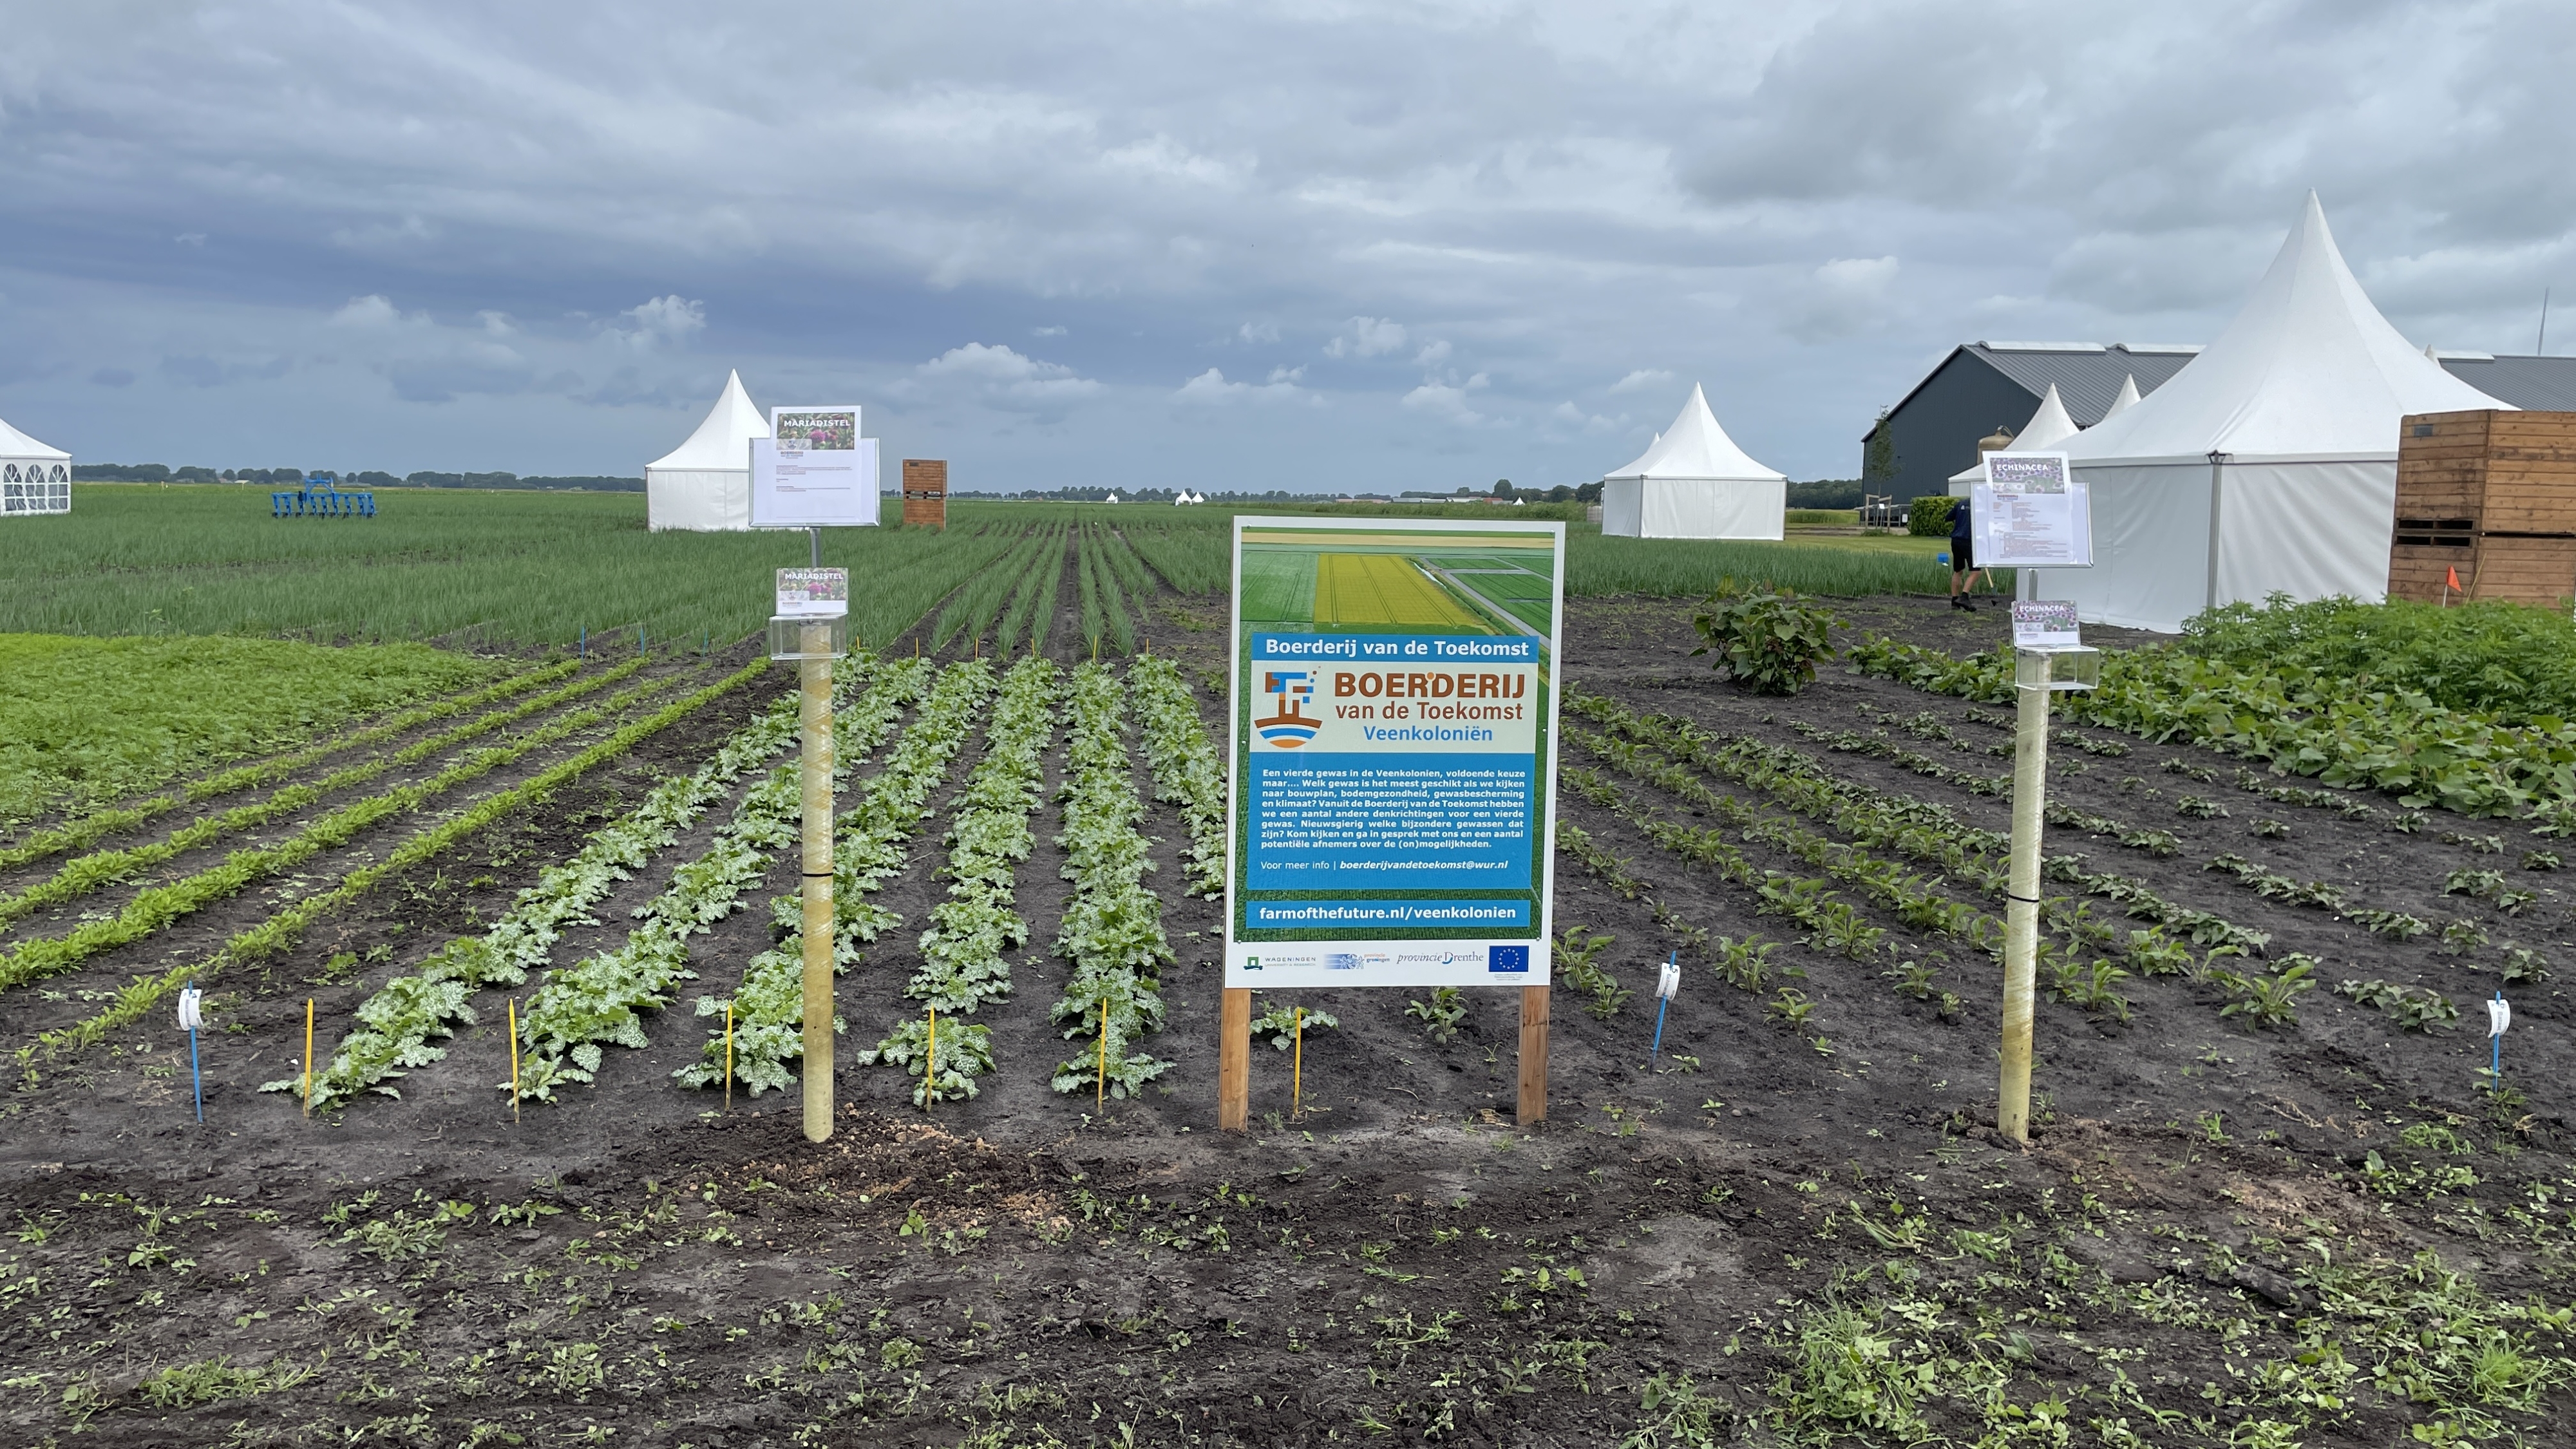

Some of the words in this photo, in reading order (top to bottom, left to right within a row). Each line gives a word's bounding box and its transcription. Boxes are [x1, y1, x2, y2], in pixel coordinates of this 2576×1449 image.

[1267, 639, 1356, 657] Boerderij
[1363, 643, 1397, 654] van
[1405, 641, 1427, 654] de
[1434, 641, 1528, 656] Toekomst
[1335, 672, 1524, 698] BOERDERIJ
[1336, 706, 1373, 719] van
[1383, 701, 1408, 719] de
[1417, 701, 1522, 719] Toekomst
[1364, 726, 1492, 741] Veenkoloniën
[1376, 770, 1443, 778] Veenkolonien,
[1421, 780, 1461, 788] geschikt
[1497, 780, 1524, 788] kijken
[1288, 790, 1336, 798] bouwplan,
[1341, 790, 1430, 798] bodemgezondheid,
[1434, 790, 1524, 799] gewasbescherming
[1365, 800, 1408, 808] Boerderij
[1373, 810, 1443, 819] denkrichtingen
[1302, 820, 1363, 829] Nieuwsgierig
[1402, 820, 1451, 829] bijzondere
[1262, 830, 1284, 839] zijn?
[1311, 830, 1339, 838] kijken
[1381, 830, 1419, 838] gesprek
[1262, 840, 1309, 849] potentiële
[1399, 840, 1491, 849] (on)mogelijkheden.
[1340, 861, 1508, 870] boerderijvandetoekomst@wur.nl
[1260, 907, 1515, 920] farmofthefuture.nl/veenkolonien
[1397, 952, 1442, 964] provincie
[1442, 952, 1484, 964] Drenthe
